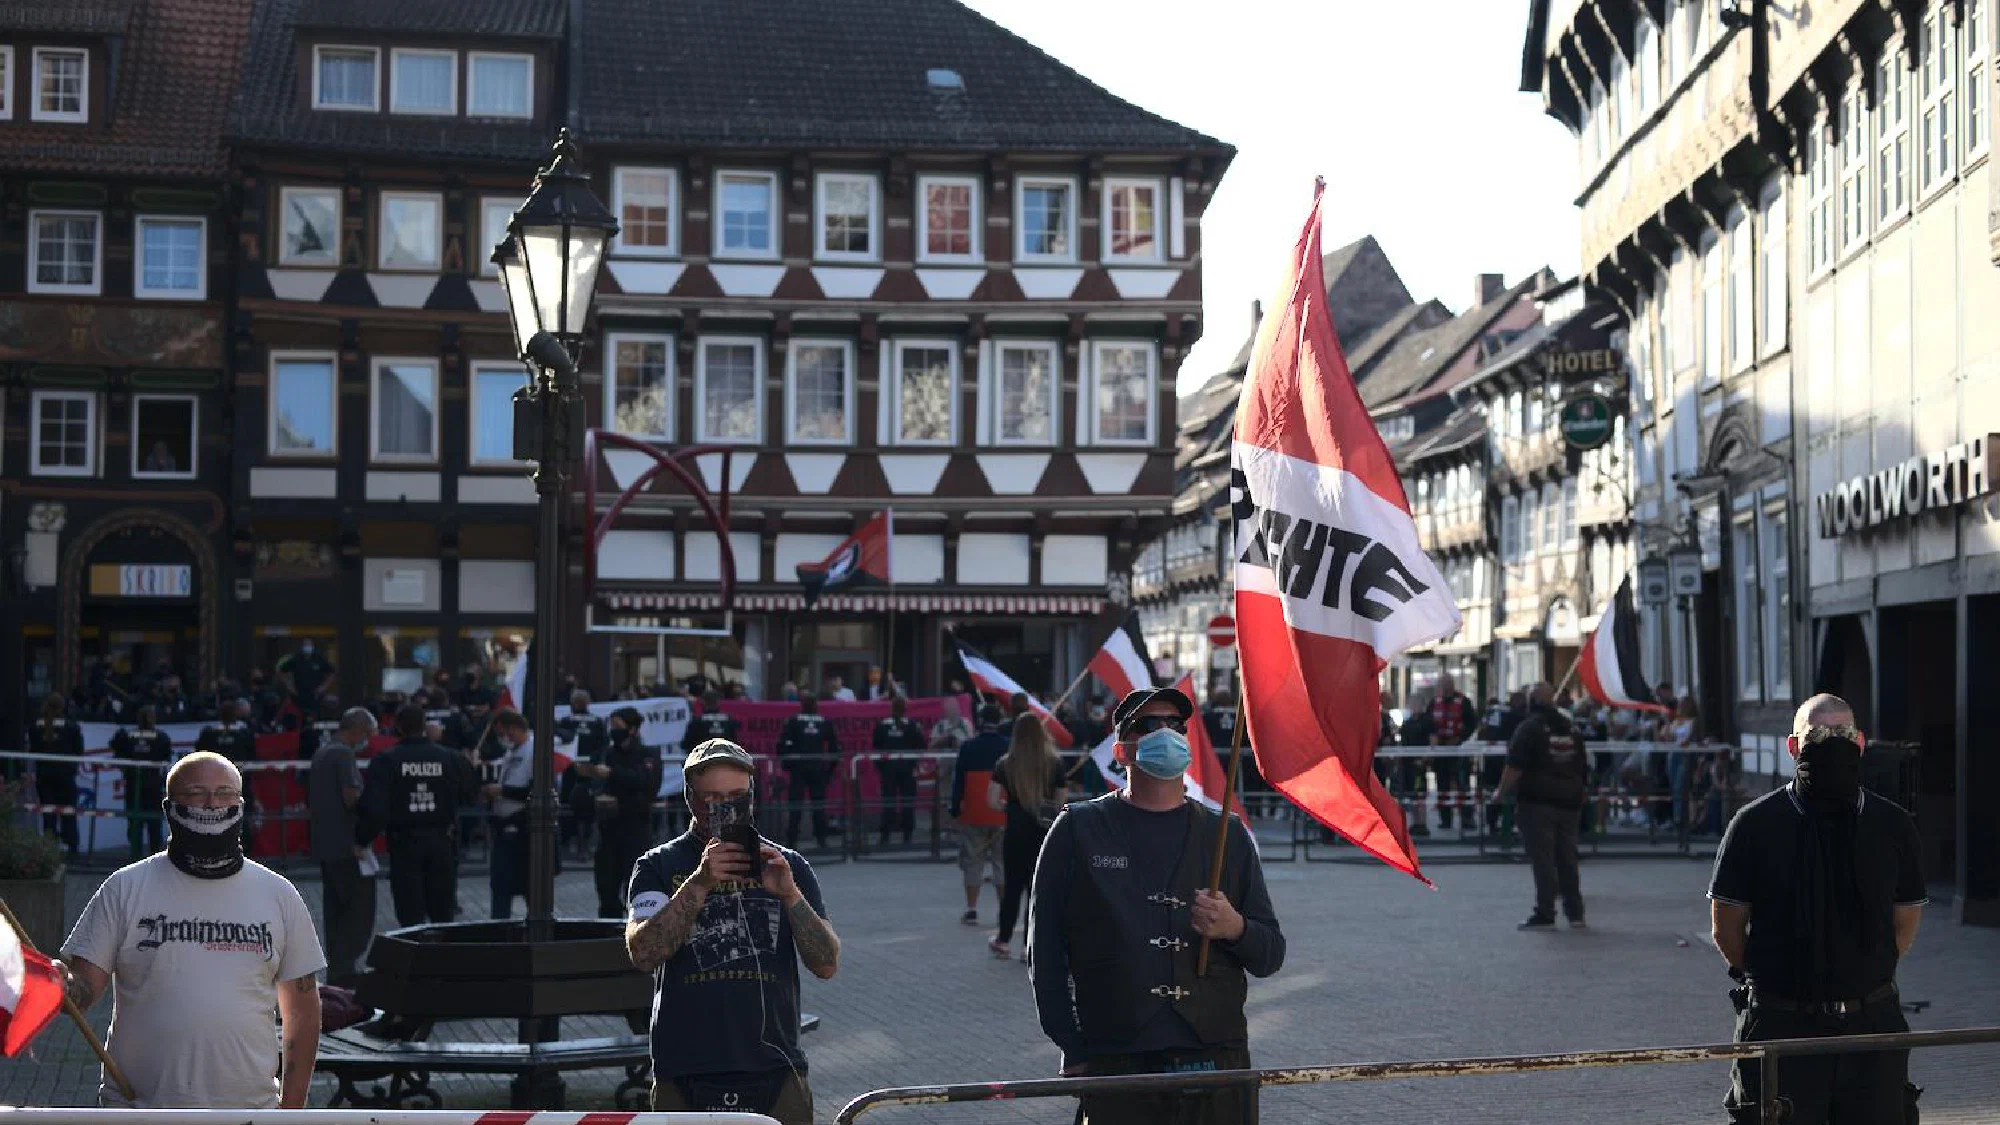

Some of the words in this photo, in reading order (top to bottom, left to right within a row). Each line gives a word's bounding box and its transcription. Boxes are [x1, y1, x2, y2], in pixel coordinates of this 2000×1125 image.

[1549, 350, 1615, 373] HOTEL
[1817, 436, 1989, 540] WOOLWORTH
[401, 761, 442, 776] POLIZEI
